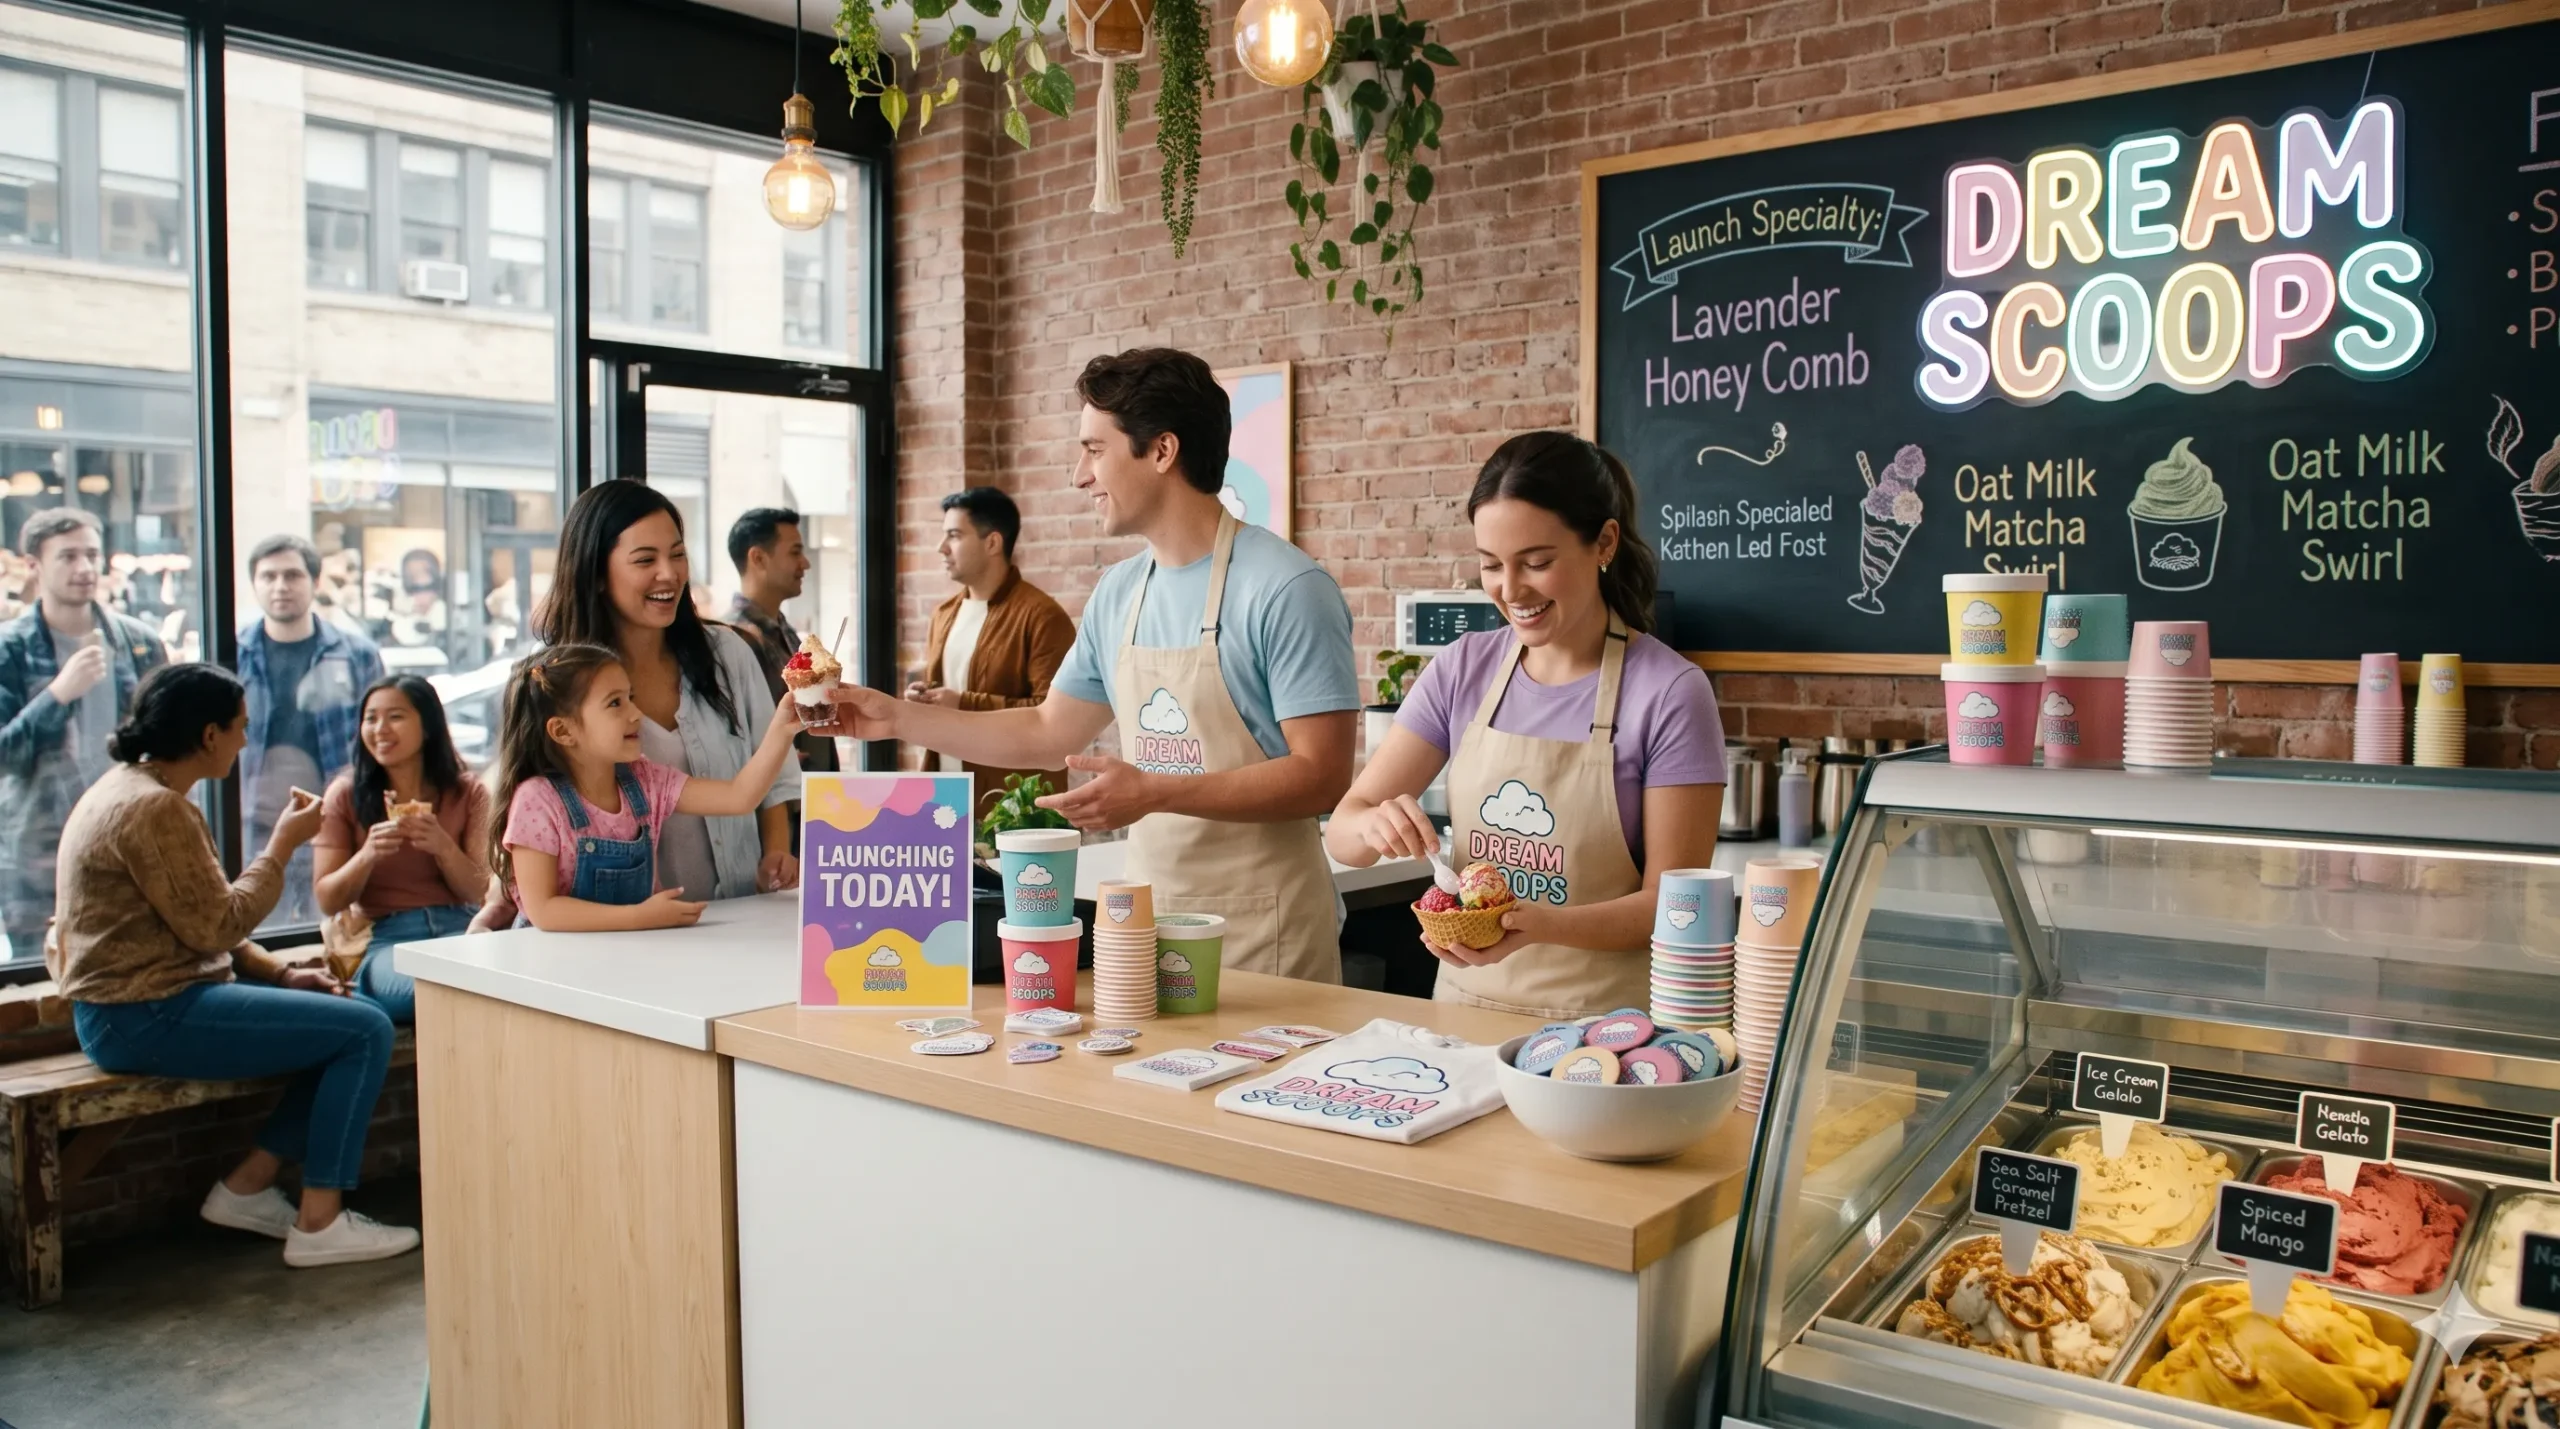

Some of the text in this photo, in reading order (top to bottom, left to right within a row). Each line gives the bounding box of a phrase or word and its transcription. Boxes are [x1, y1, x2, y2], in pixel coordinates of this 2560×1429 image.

[1947, 102, 2394, 278] DREAM
[1651, 195, 1882, 266] Launch Specialty:
[1672, 276, 1840, 342] Lavender
[1920, 240, 2424, 405] SCOOPS
[2530, 308, 2560, 348] P
[1645, 332, 1870, 412] Honey Comb
[2269, 430, 2446, 481] Oat Milk
[1954, 458, 2097, 503] Oat Milk
[1736, 495, 1832, 531] Specialed
[2282, 485, 2431, 531] Matcha
[1660, 532, 1827, 561] Kathen Led Fost
[1965, 507, 2085, 548] Matcha
[2300, 538, 2403, 582] Swirl
[1136, 736, 1202, 765] DREAM
[818, 845, 955, 868] LAUNCHING
[1470, 830, 1564, 874] DREAM
[820, 873, 951, 908] TODAY!
[1274, 1076, 1440, 1114] DREAM
[2087, 1064, 2158, 1089] Ice Cream
[1241, 1089, 1414, 1128] SCOOPS
[2316, 1123, 2369, 1145] Gelato
[1990, 1157, 2061, 1185] Sea Salt
[1992, 1177, 2055, 1202] Caramel
[1995, 1194, 2051, 1220] Pretzel
[2240, 1198, 2306, 1227] Spiced
[2241, 1223, 2304, 1256] Mango
